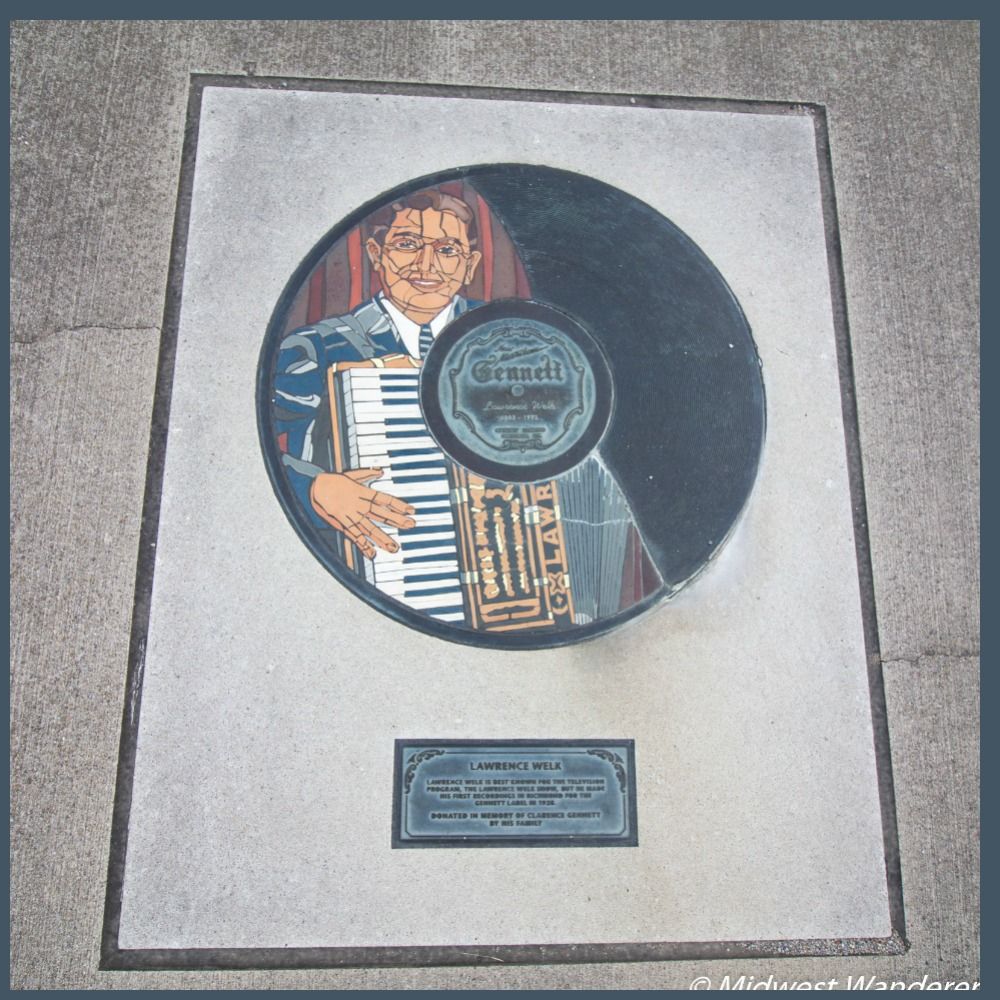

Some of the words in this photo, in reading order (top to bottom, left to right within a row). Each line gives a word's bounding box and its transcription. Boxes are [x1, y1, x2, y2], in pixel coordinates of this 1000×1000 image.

[471, 354, 564, 383] Gennett
[470, 762, 530, 770] LAWRENCE
[532, 762, 562, 770] WELK
